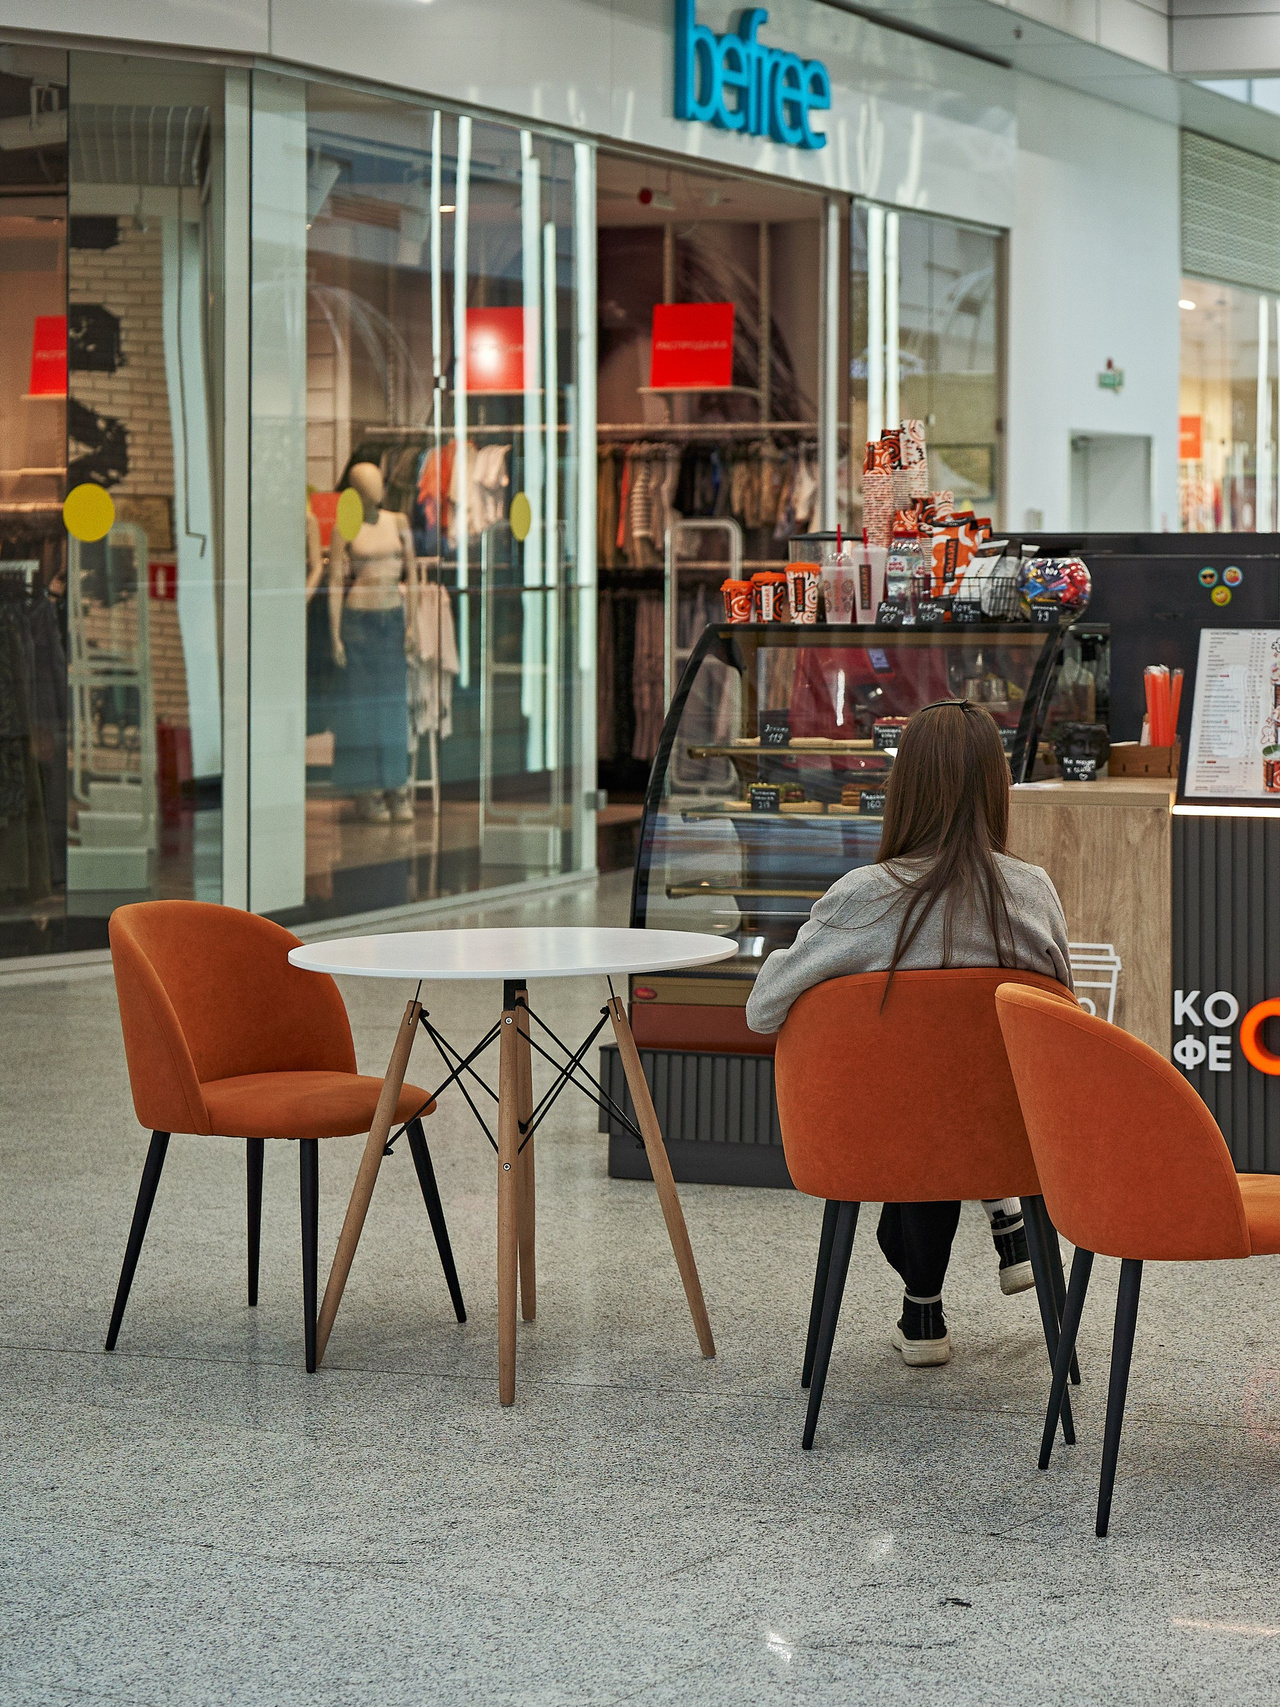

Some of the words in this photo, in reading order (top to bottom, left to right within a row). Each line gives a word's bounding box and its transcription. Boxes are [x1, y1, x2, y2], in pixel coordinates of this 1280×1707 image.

[675, 0, 830, 149] befree
[1174, 990, 1239, 1028] КО
[1173, 1034, 1231, 1072] ФЕ
